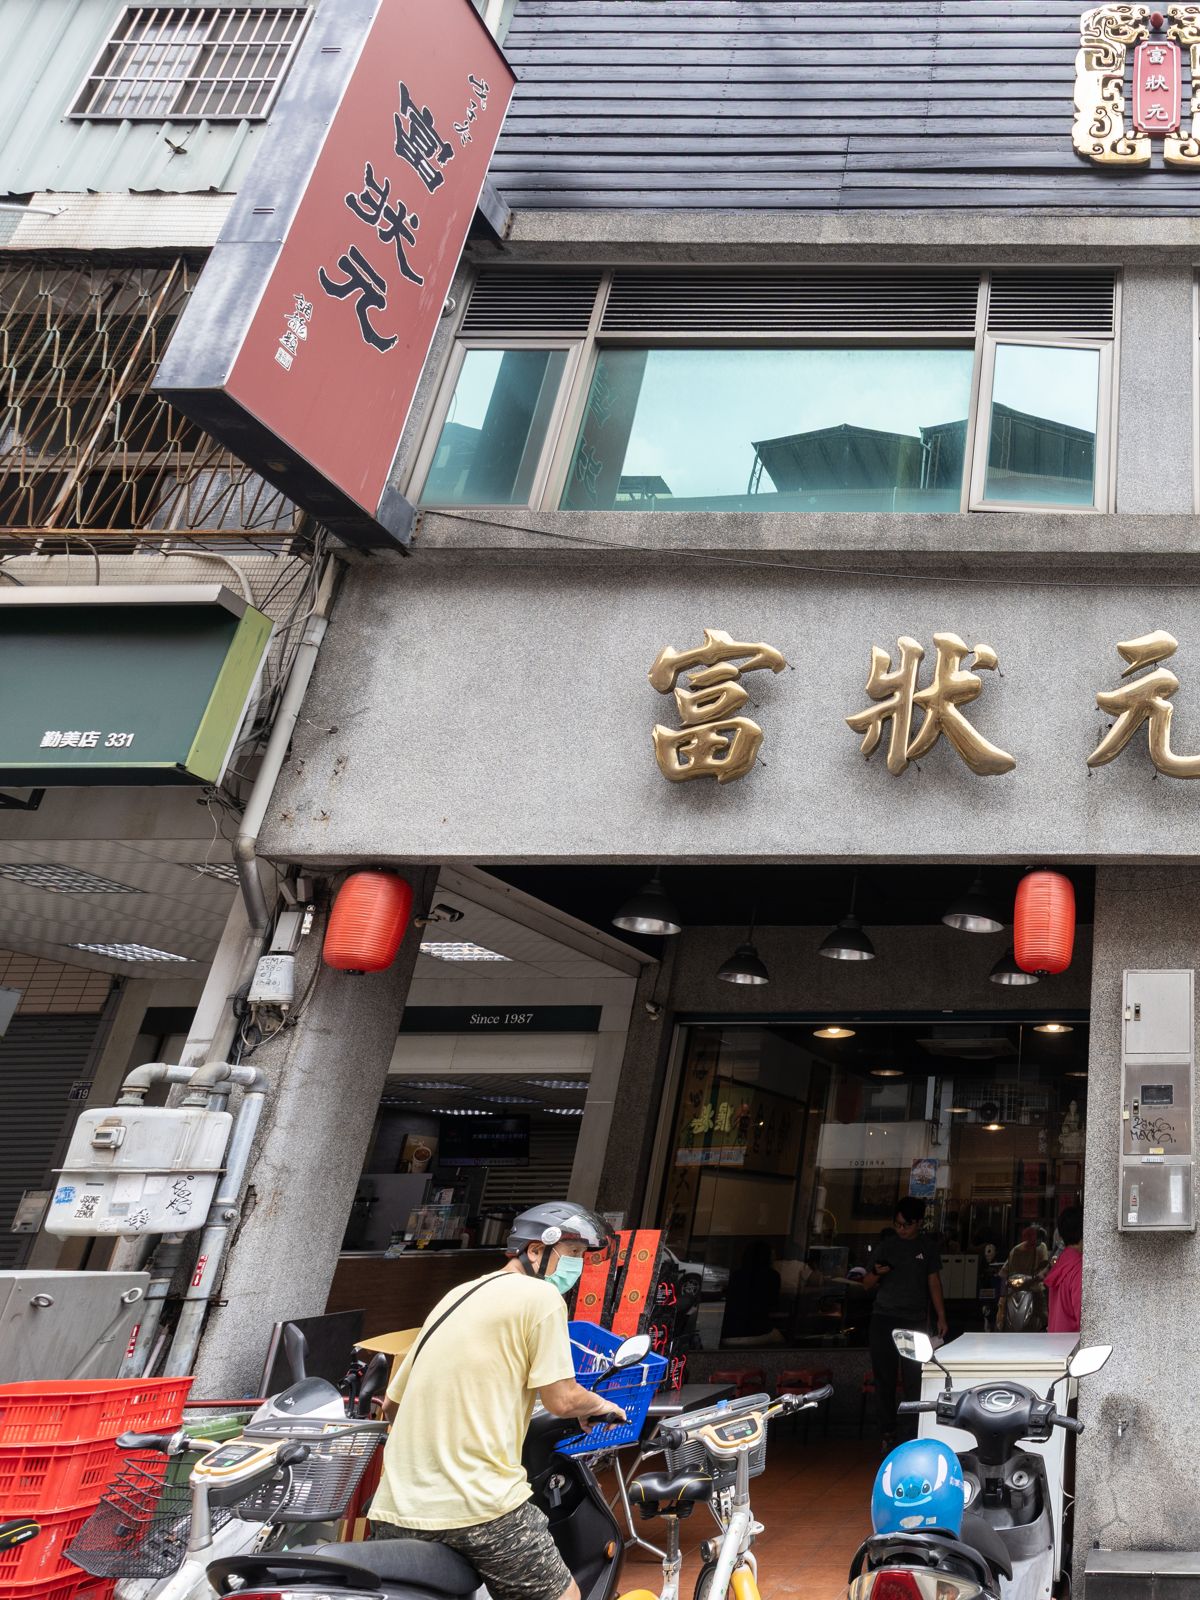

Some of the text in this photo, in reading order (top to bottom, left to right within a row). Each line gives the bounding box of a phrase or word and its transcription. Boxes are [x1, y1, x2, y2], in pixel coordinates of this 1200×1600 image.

[1145, 47, 1169, 121] 富狀元
[318, 81, 455, 353] 富狀元
[40, 731, 135, 748] 勤美店 331
[469, 1014, 534, 1024] Since 1987
